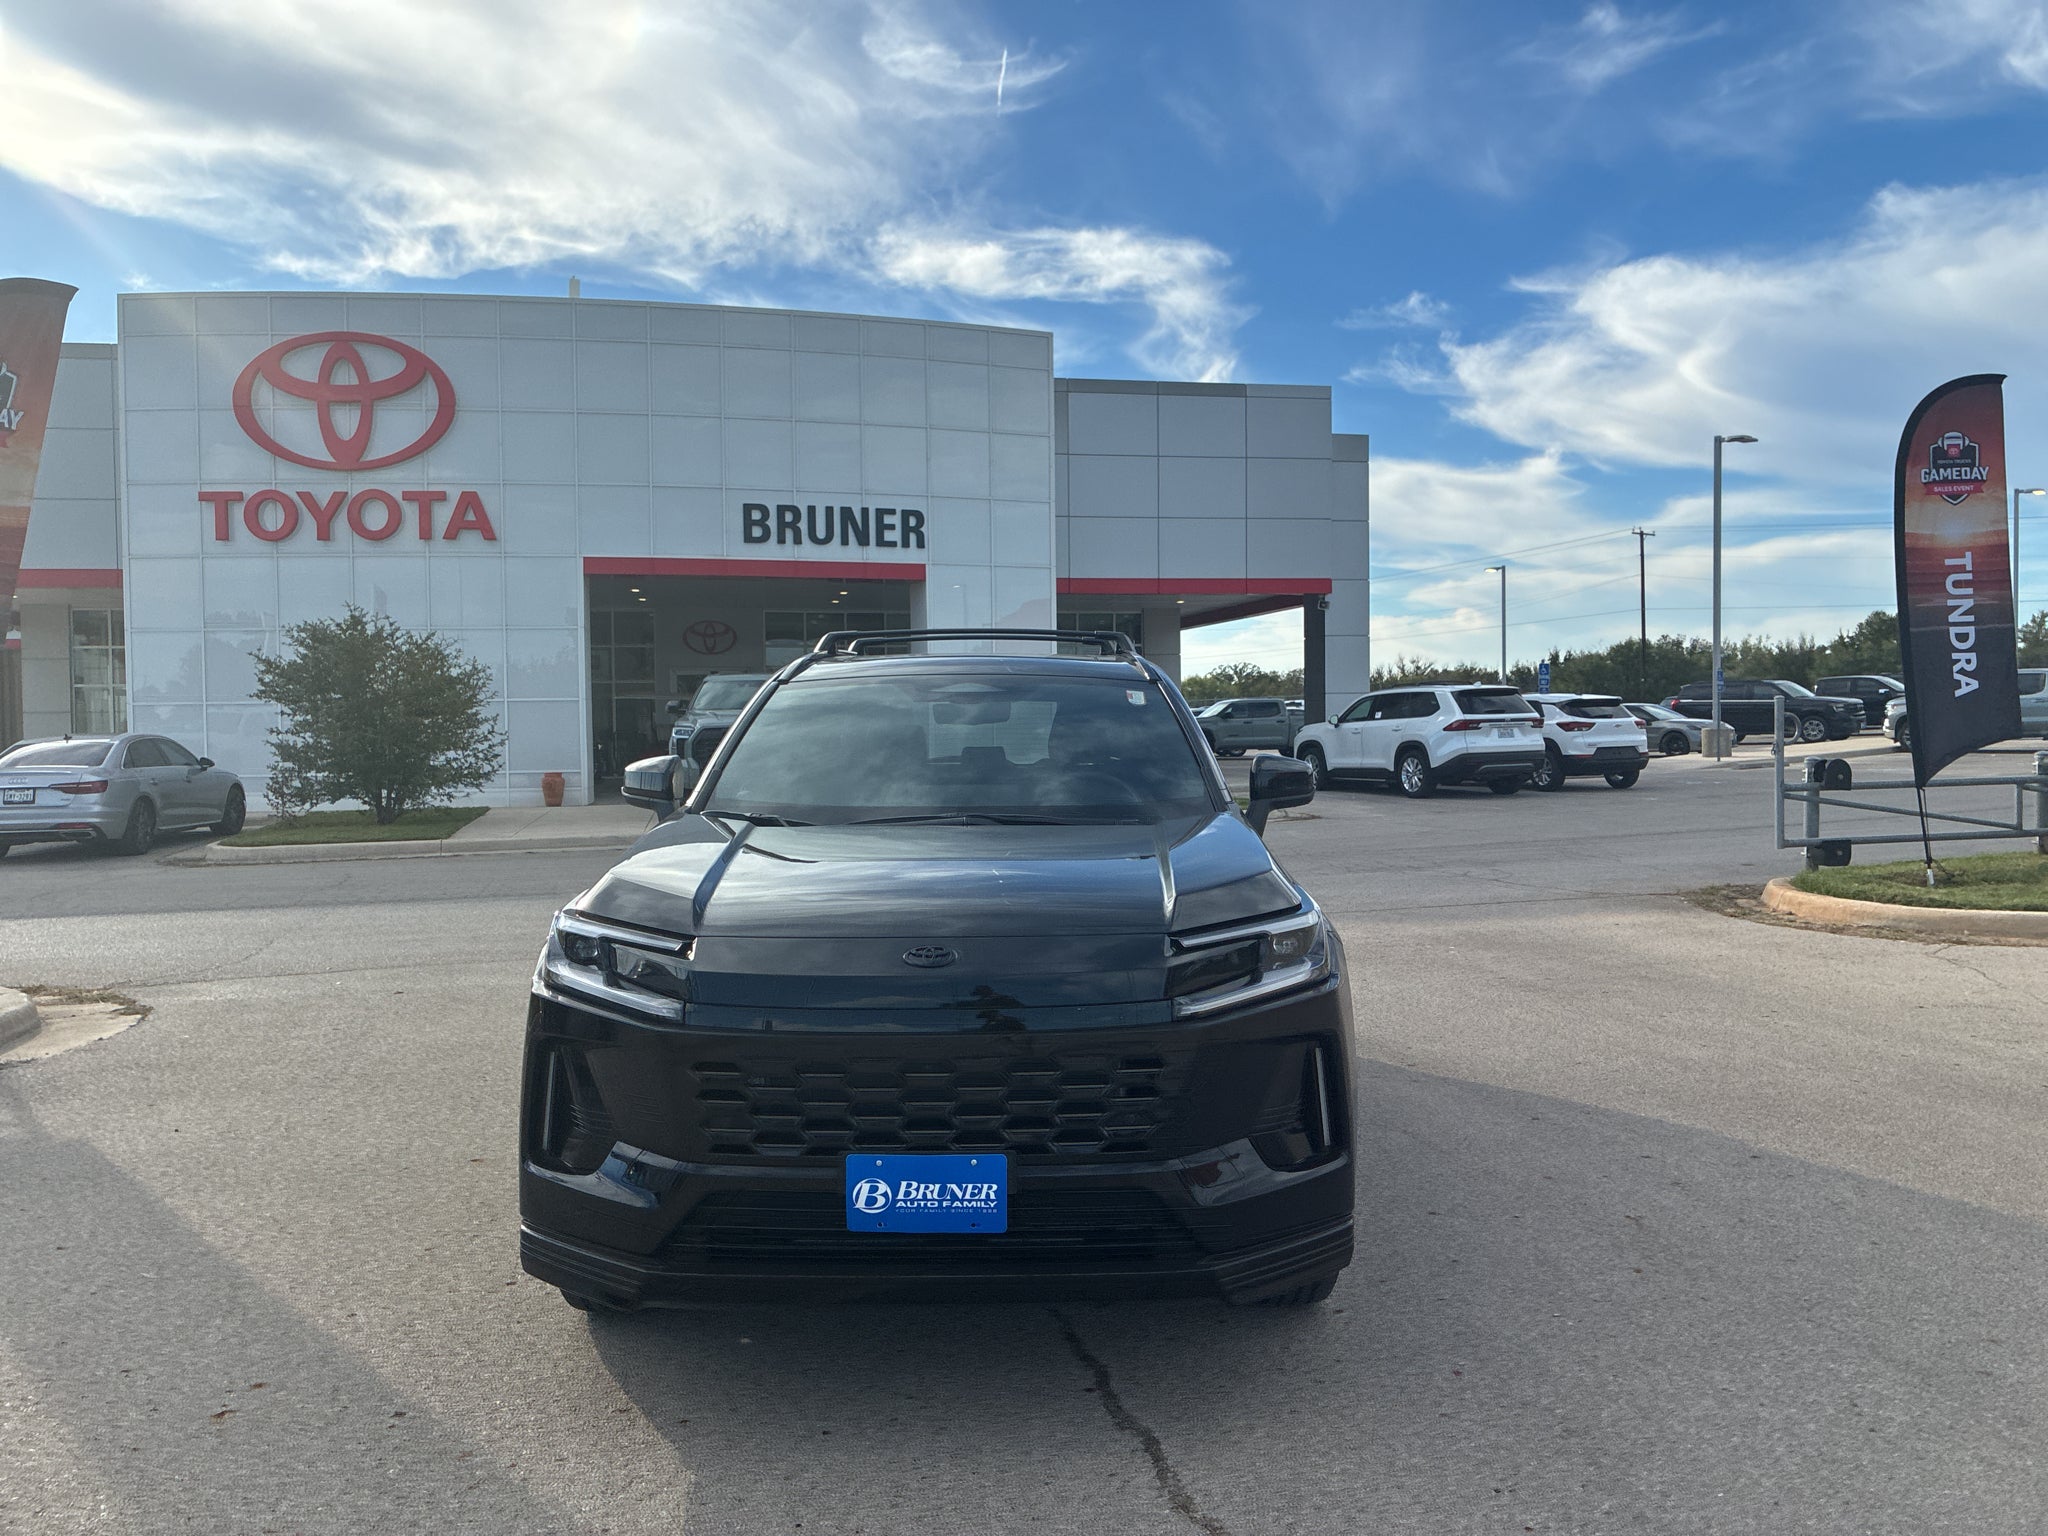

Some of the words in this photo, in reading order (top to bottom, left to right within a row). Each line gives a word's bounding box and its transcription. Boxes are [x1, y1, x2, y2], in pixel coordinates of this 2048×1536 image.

[1920, 466, 1989, 483] GAMEDAY
[1953, 484, 1974, 492] EVENT
[198, 488, 497, 542] TOYOTA
[742, 502, 926, 550] BRUNER
[1944, 551, 1980, 698] TUNDRA
[895, 1180, 998, 1200] BRUNER
